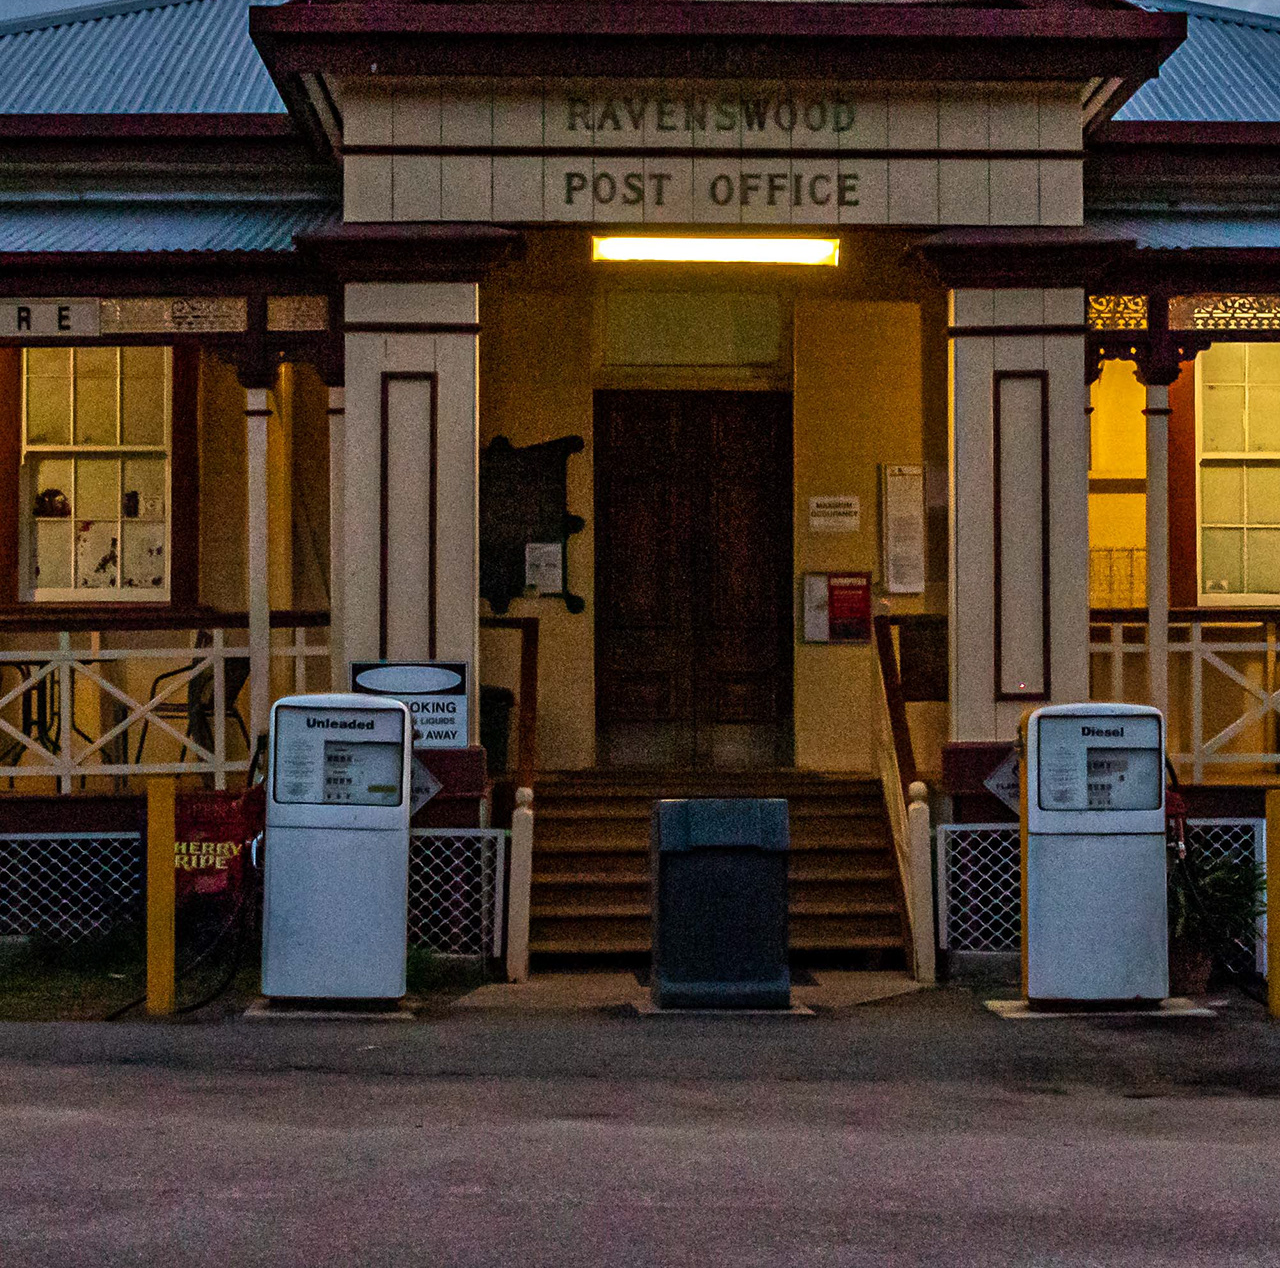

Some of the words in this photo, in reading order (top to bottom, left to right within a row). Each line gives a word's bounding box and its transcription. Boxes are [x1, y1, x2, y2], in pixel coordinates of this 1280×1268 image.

[568, 97, 856, 131] RAVENSWOOD
[565, 172, 671, 206] POST
[709, 172, 860, 207] OFFICE
[405, 701, 457, 714] OKING
[306, 717, 375, 731] Unleaded
[420, 717, 456, 726] LIQUIDS
[426, 730, 458, 741] AWAY
[1081, 726, 1125, 738] Diesel
[174, 841, 243, 859] HERRY
[174, 854, 229, 871] RIPE
